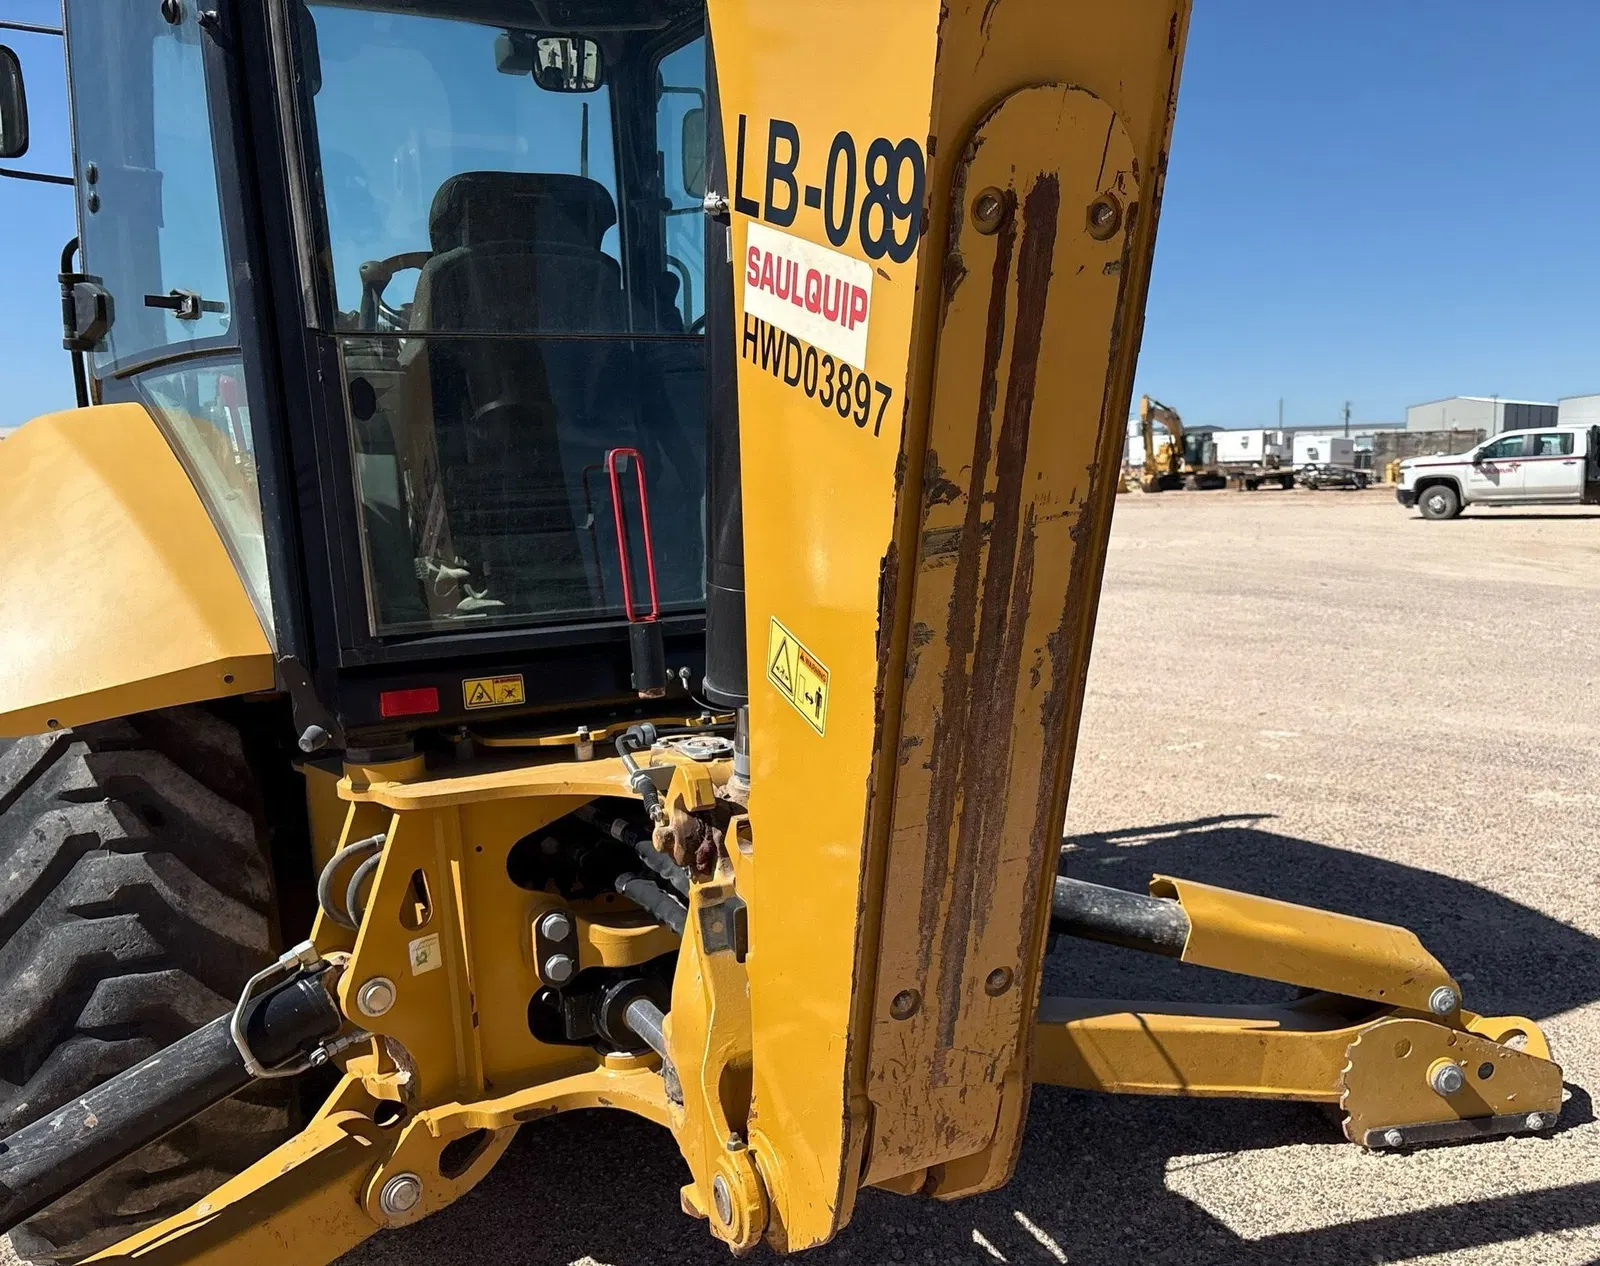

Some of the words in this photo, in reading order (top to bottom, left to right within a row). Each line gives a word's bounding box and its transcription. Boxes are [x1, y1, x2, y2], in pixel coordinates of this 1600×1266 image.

[734, 114, 925, 263] LB-089
[747, 246, 868, 331] SAULQUIP
[742, 313, 892, 437] HWD03897
